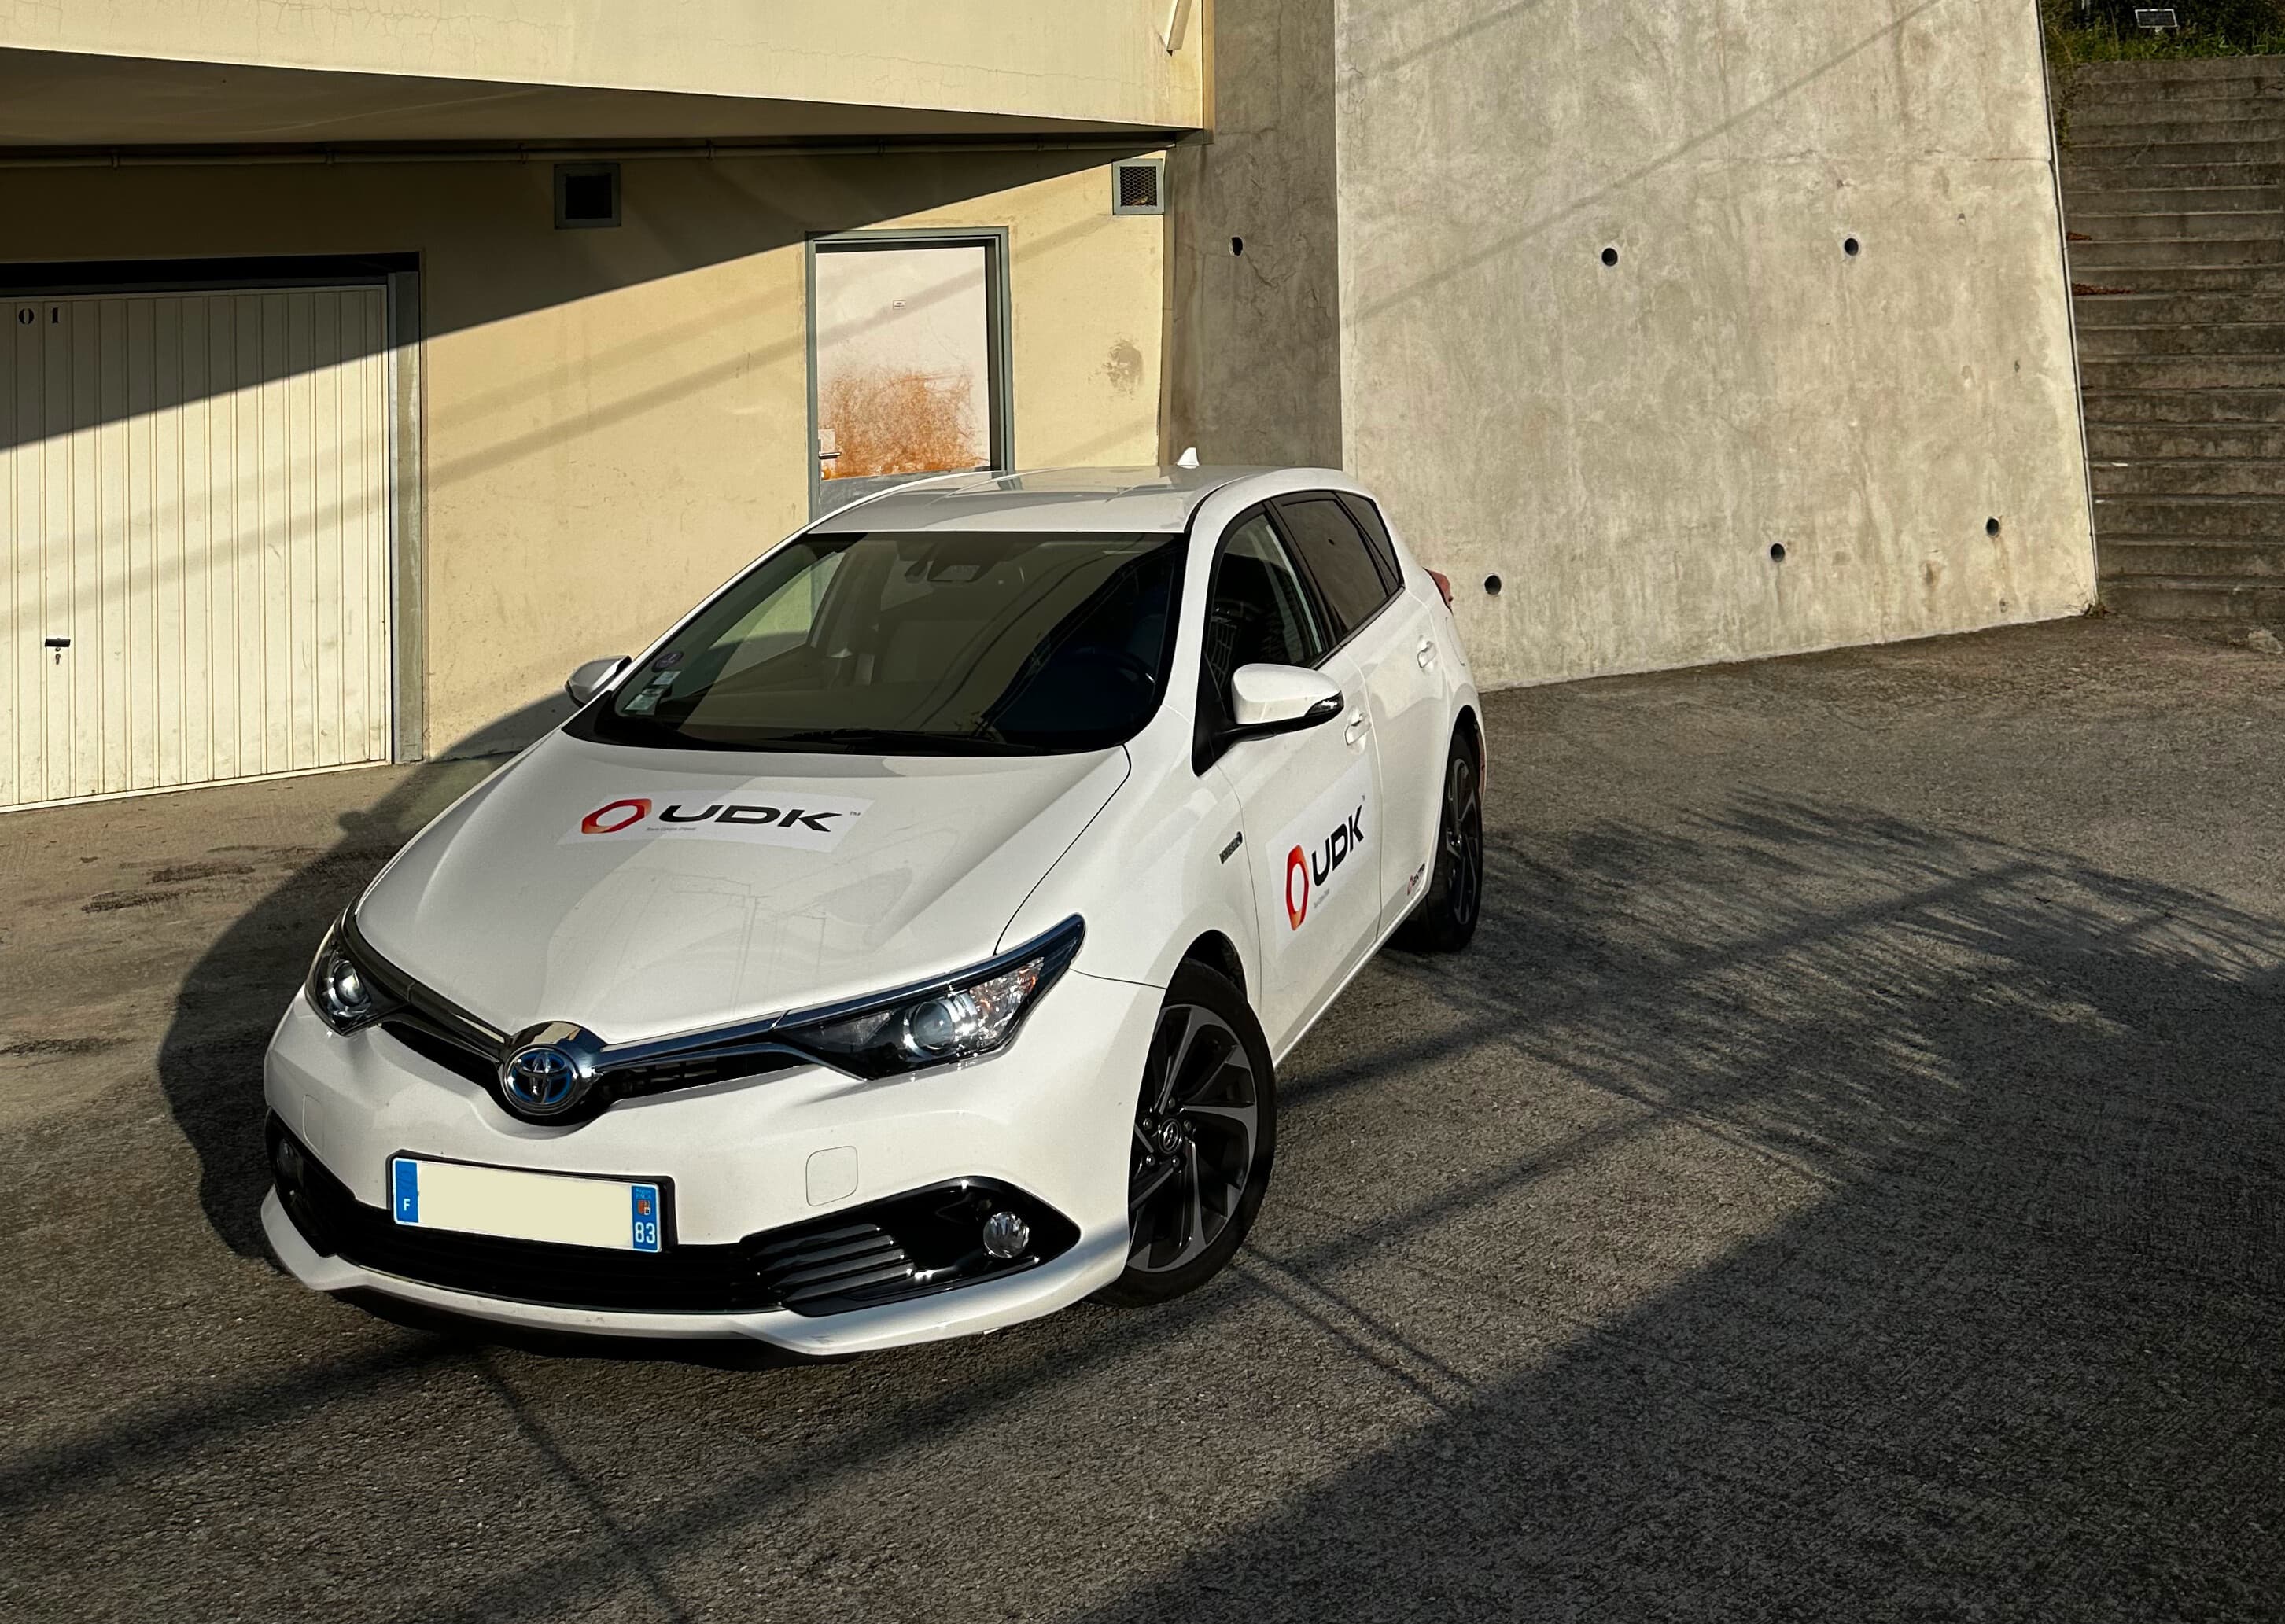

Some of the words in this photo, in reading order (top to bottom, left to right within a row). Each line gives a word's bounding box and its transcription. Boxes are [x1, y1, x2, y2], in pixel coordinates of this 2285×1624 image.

[658, 805, 842, 832] UDK
[1311, 805, 1364, 886] UDK
[403, 1198, 411, 1211] F
[635, 1221, 656, 1244] 83
